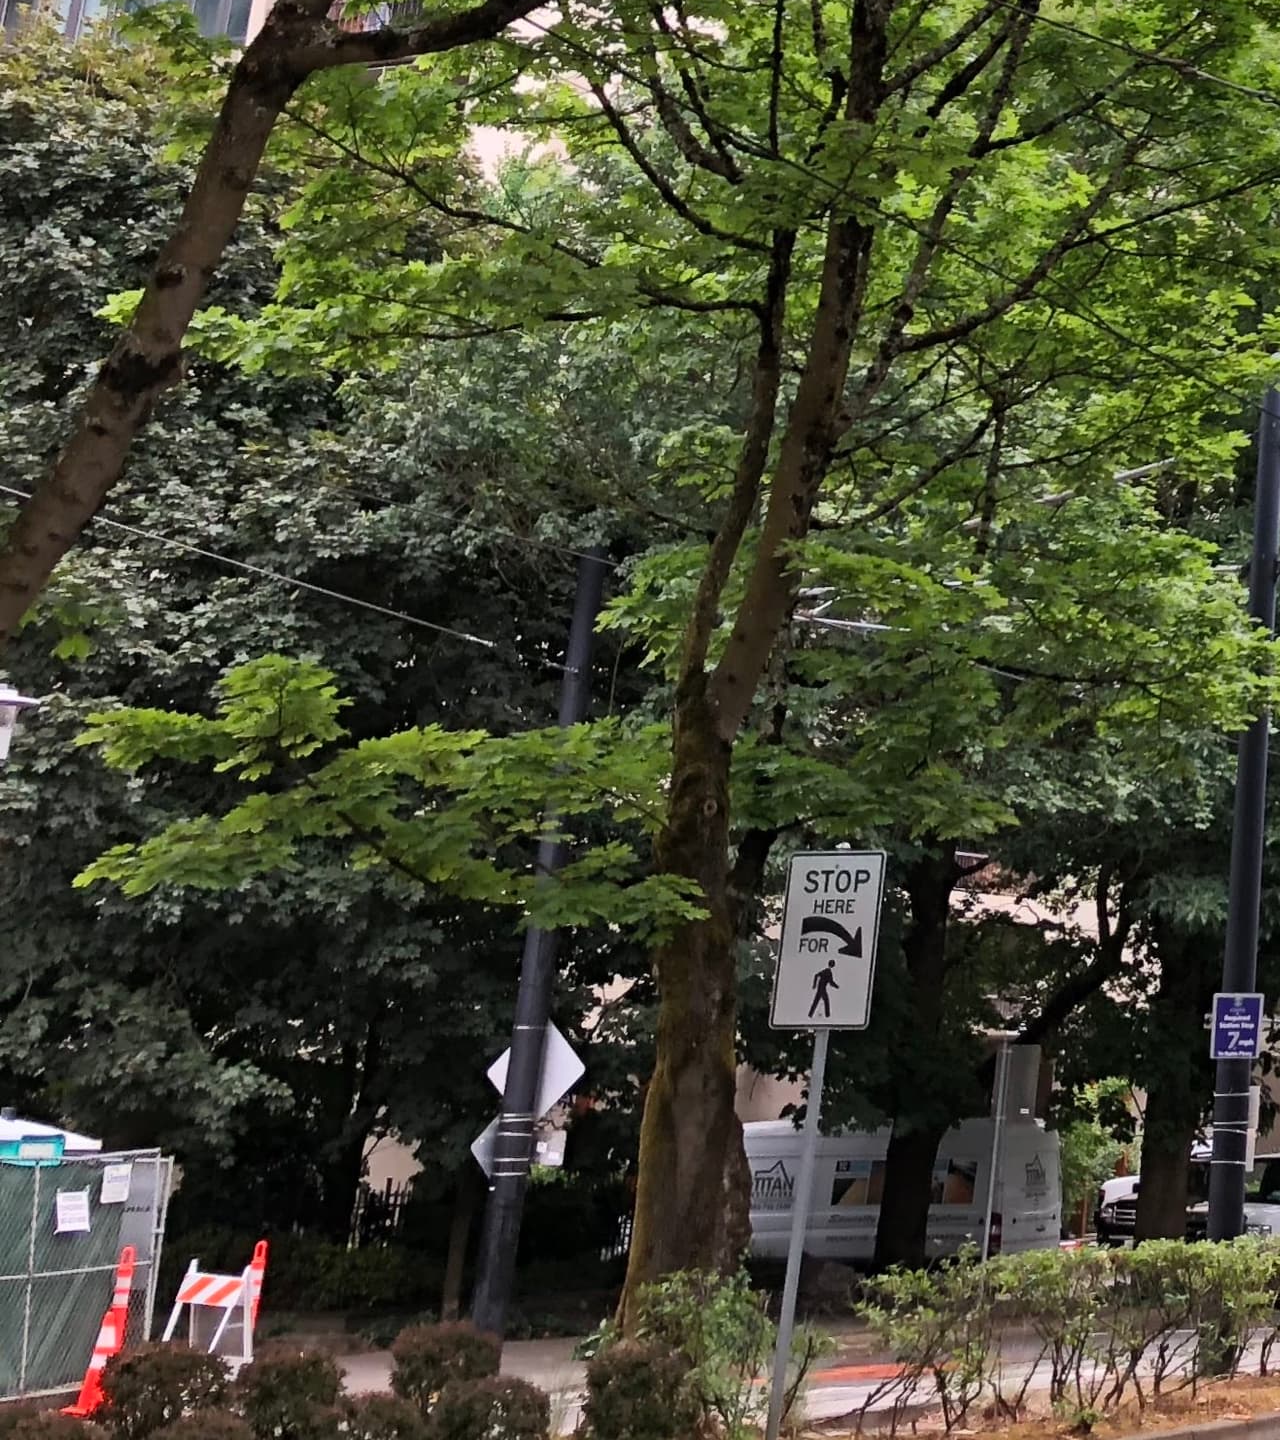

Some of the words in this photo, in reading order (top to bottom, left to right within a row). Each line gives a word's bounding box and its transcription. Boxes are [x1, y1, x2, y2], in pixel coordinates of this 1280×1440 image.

[803, 869, 871, 894] STOP
[812, 899, 856, 914] HERE
[798, 938, 829, 953] FOR
[754, 1174, 795, 1197] TITAN
